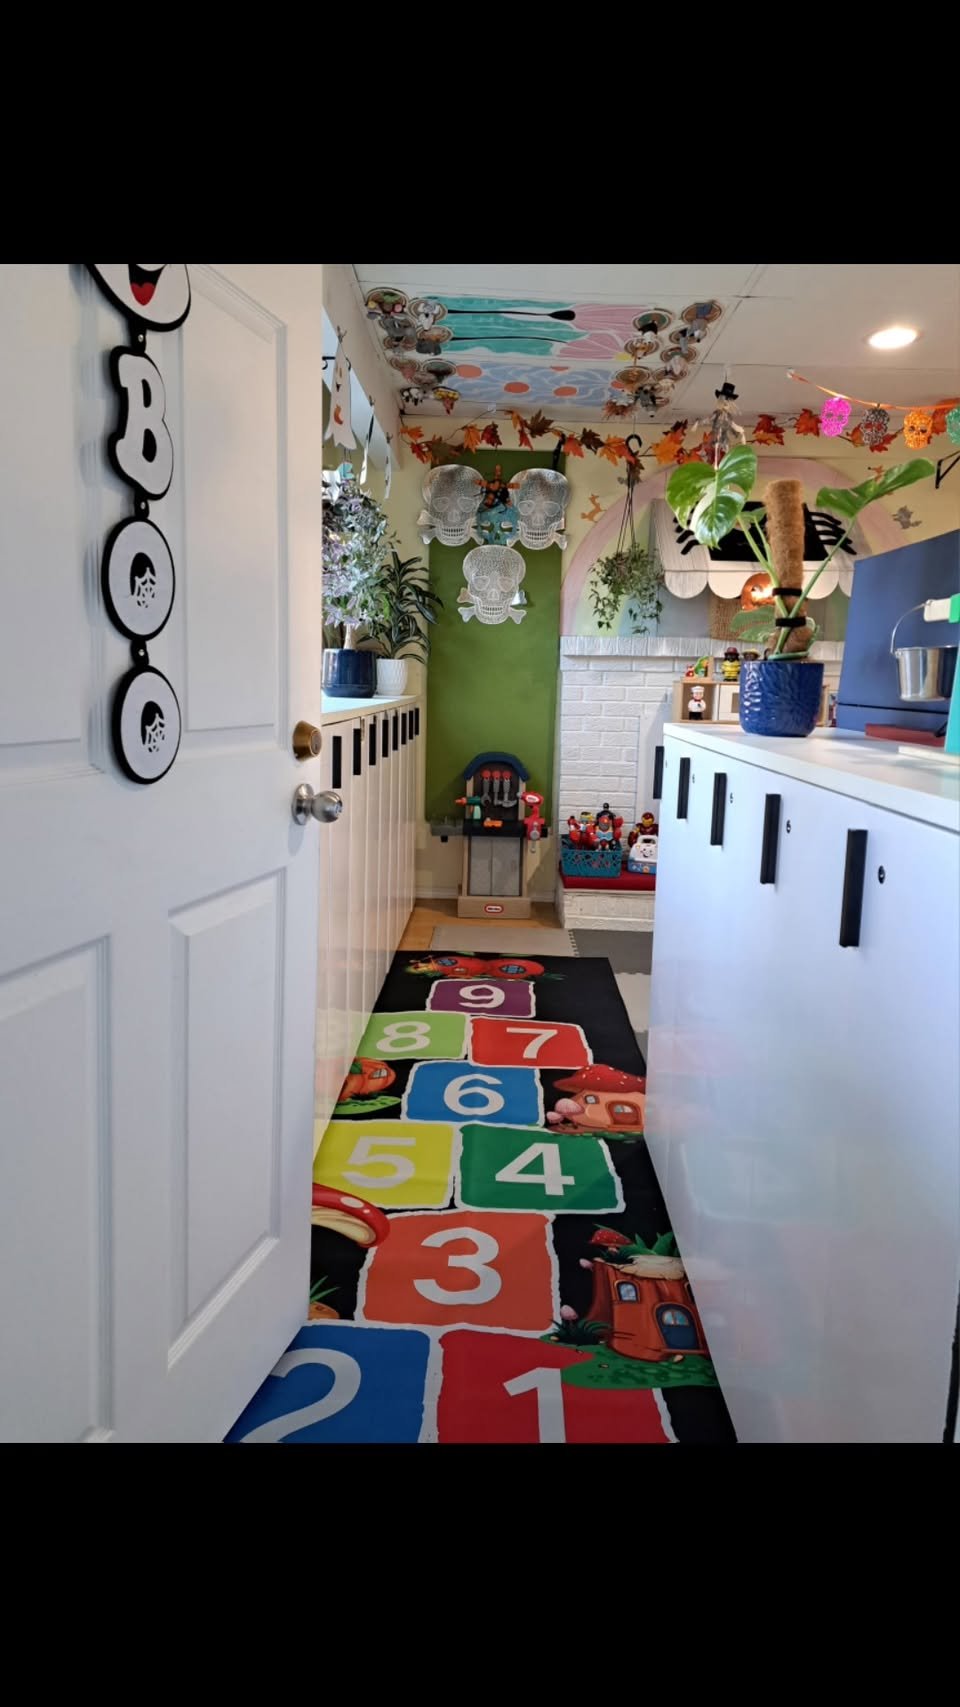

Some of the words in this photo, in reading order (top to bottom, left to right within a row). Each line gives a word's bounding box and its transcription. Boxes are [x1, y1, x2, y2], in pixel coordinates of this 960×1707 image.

[459, 985, 505, 1009] 9
[376, 1021, 431, 1054] 8
[506, 1027, 558, 1059] 7
[444, 1074, 505, 1115] 6
[341, 1137, 416, 1188] 5
[495, 1143, 575, 1196] 4
[413, 1227, 502, 1305] 3
[240, 1348, 362, 1442] 2
[503, 1367, 566, 1442] 1
